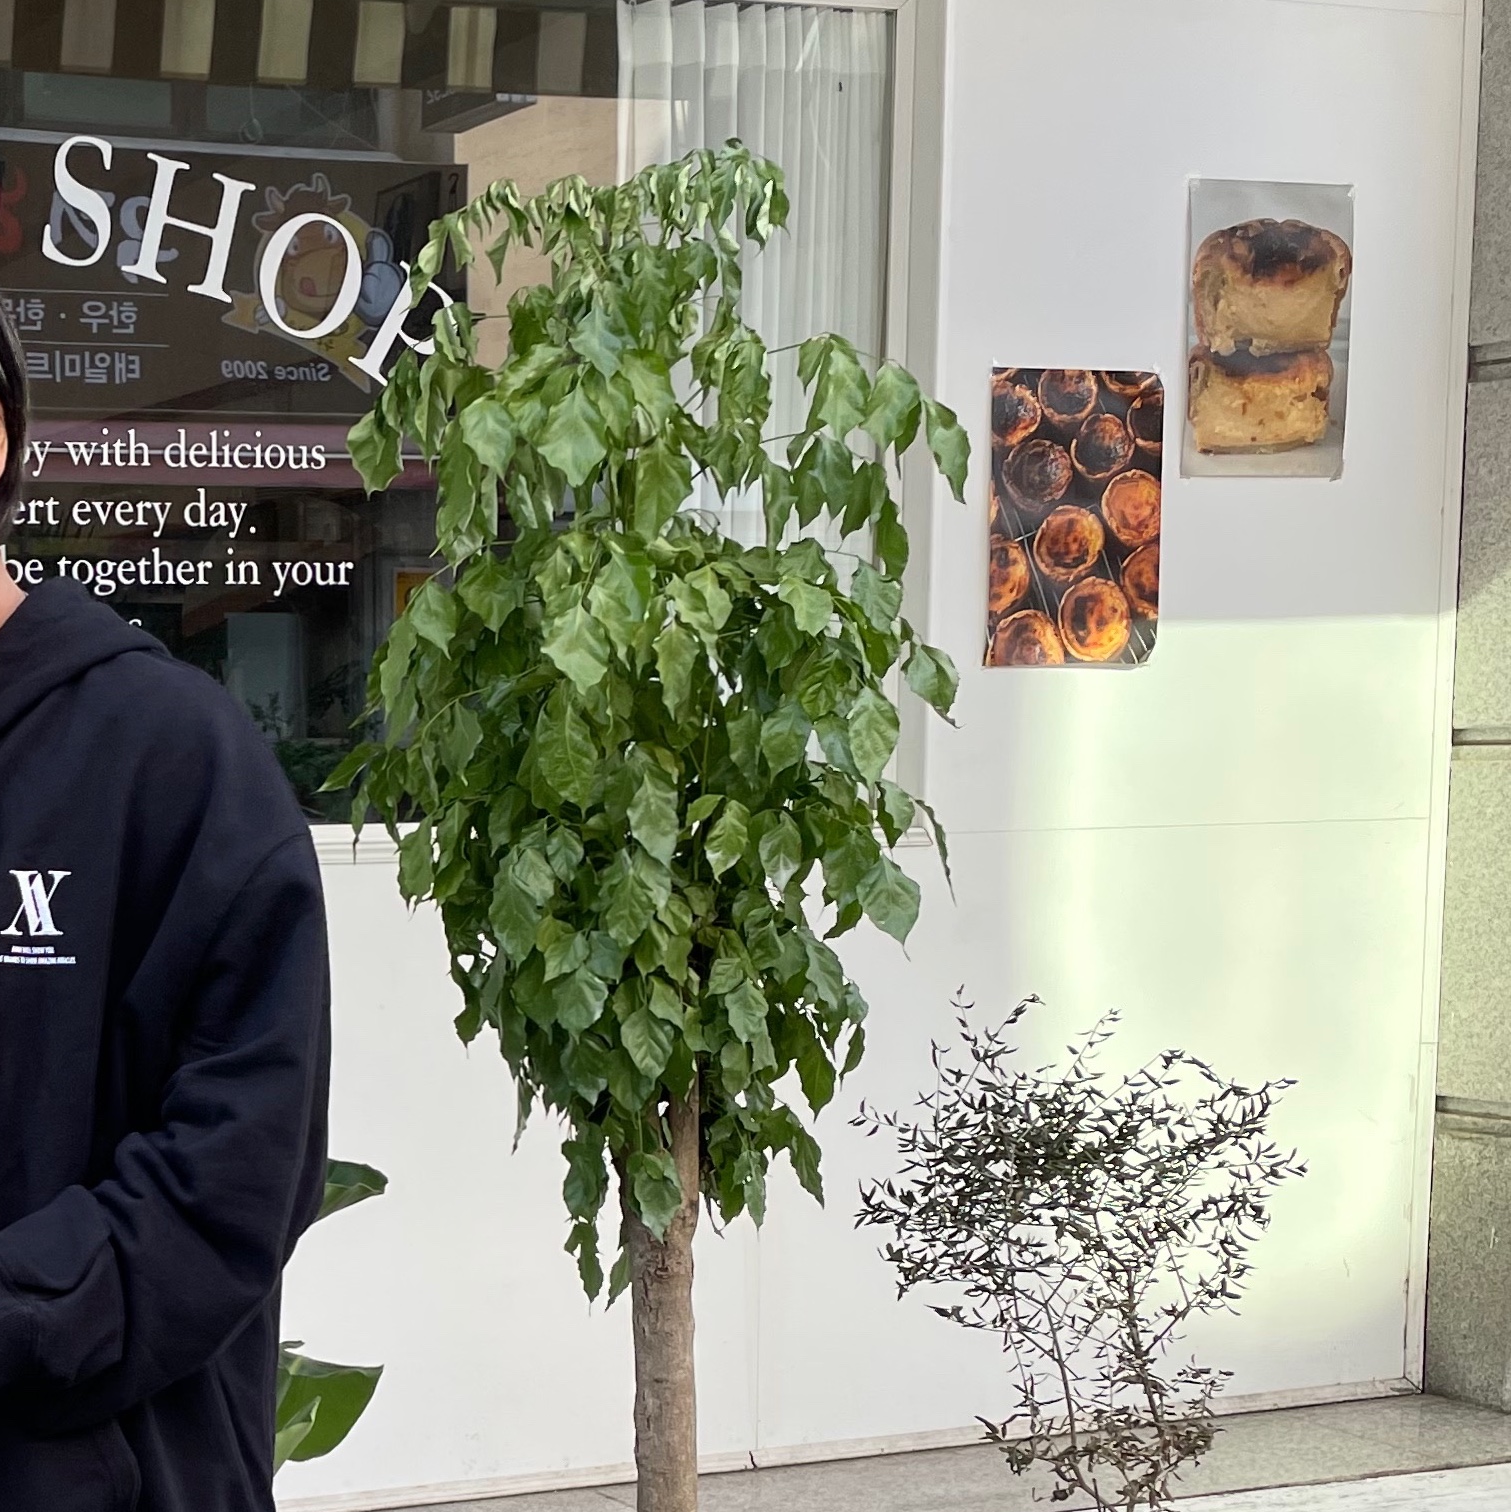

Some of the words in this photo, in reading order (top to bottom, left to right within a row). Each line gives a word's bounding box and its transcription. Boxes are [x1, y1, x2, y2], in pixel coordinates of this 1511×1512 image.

[64, 428, 151, 467] with
[163, 428, 327, 470] delicious
[71, 500, 173, 538] every
[183, 487, 257, 539] day.
[56, 547, 214, 597] together
[224, 547, 261, 586] in
[272, 560, 355, 597] your
